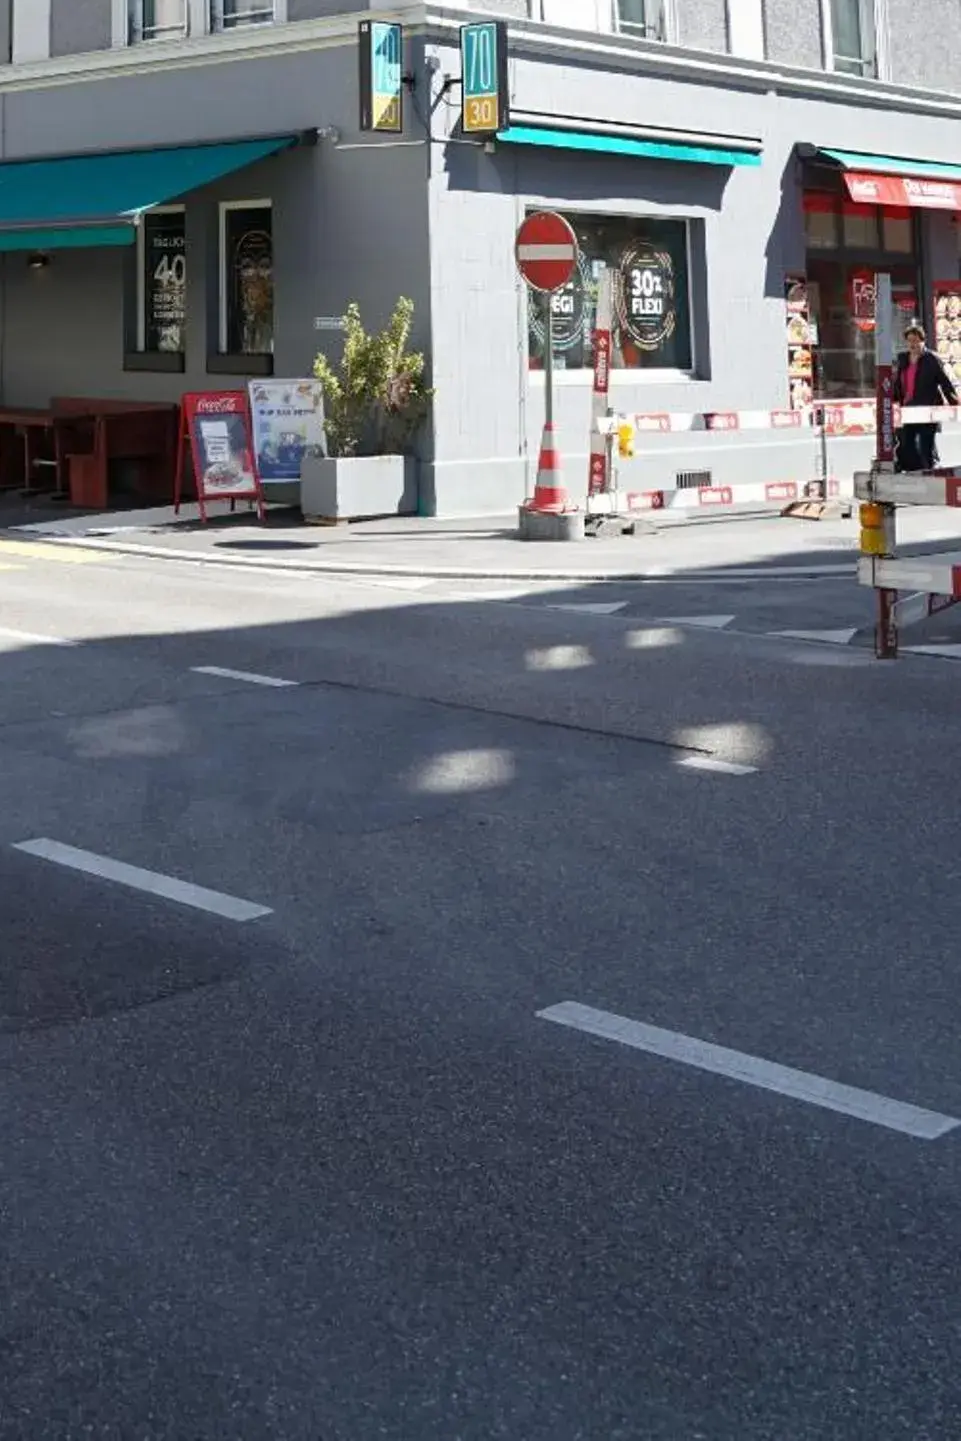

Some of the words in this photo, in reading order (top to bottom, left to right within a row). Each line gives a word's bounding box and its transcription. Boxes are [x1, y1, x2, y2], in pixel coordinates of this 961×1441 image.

[468, 30, 492, 91] 70
[471, 100, 491, 123] 30
[551, 295, 574, 313] EGI
[631, 297, 663, 315] FLEXI
